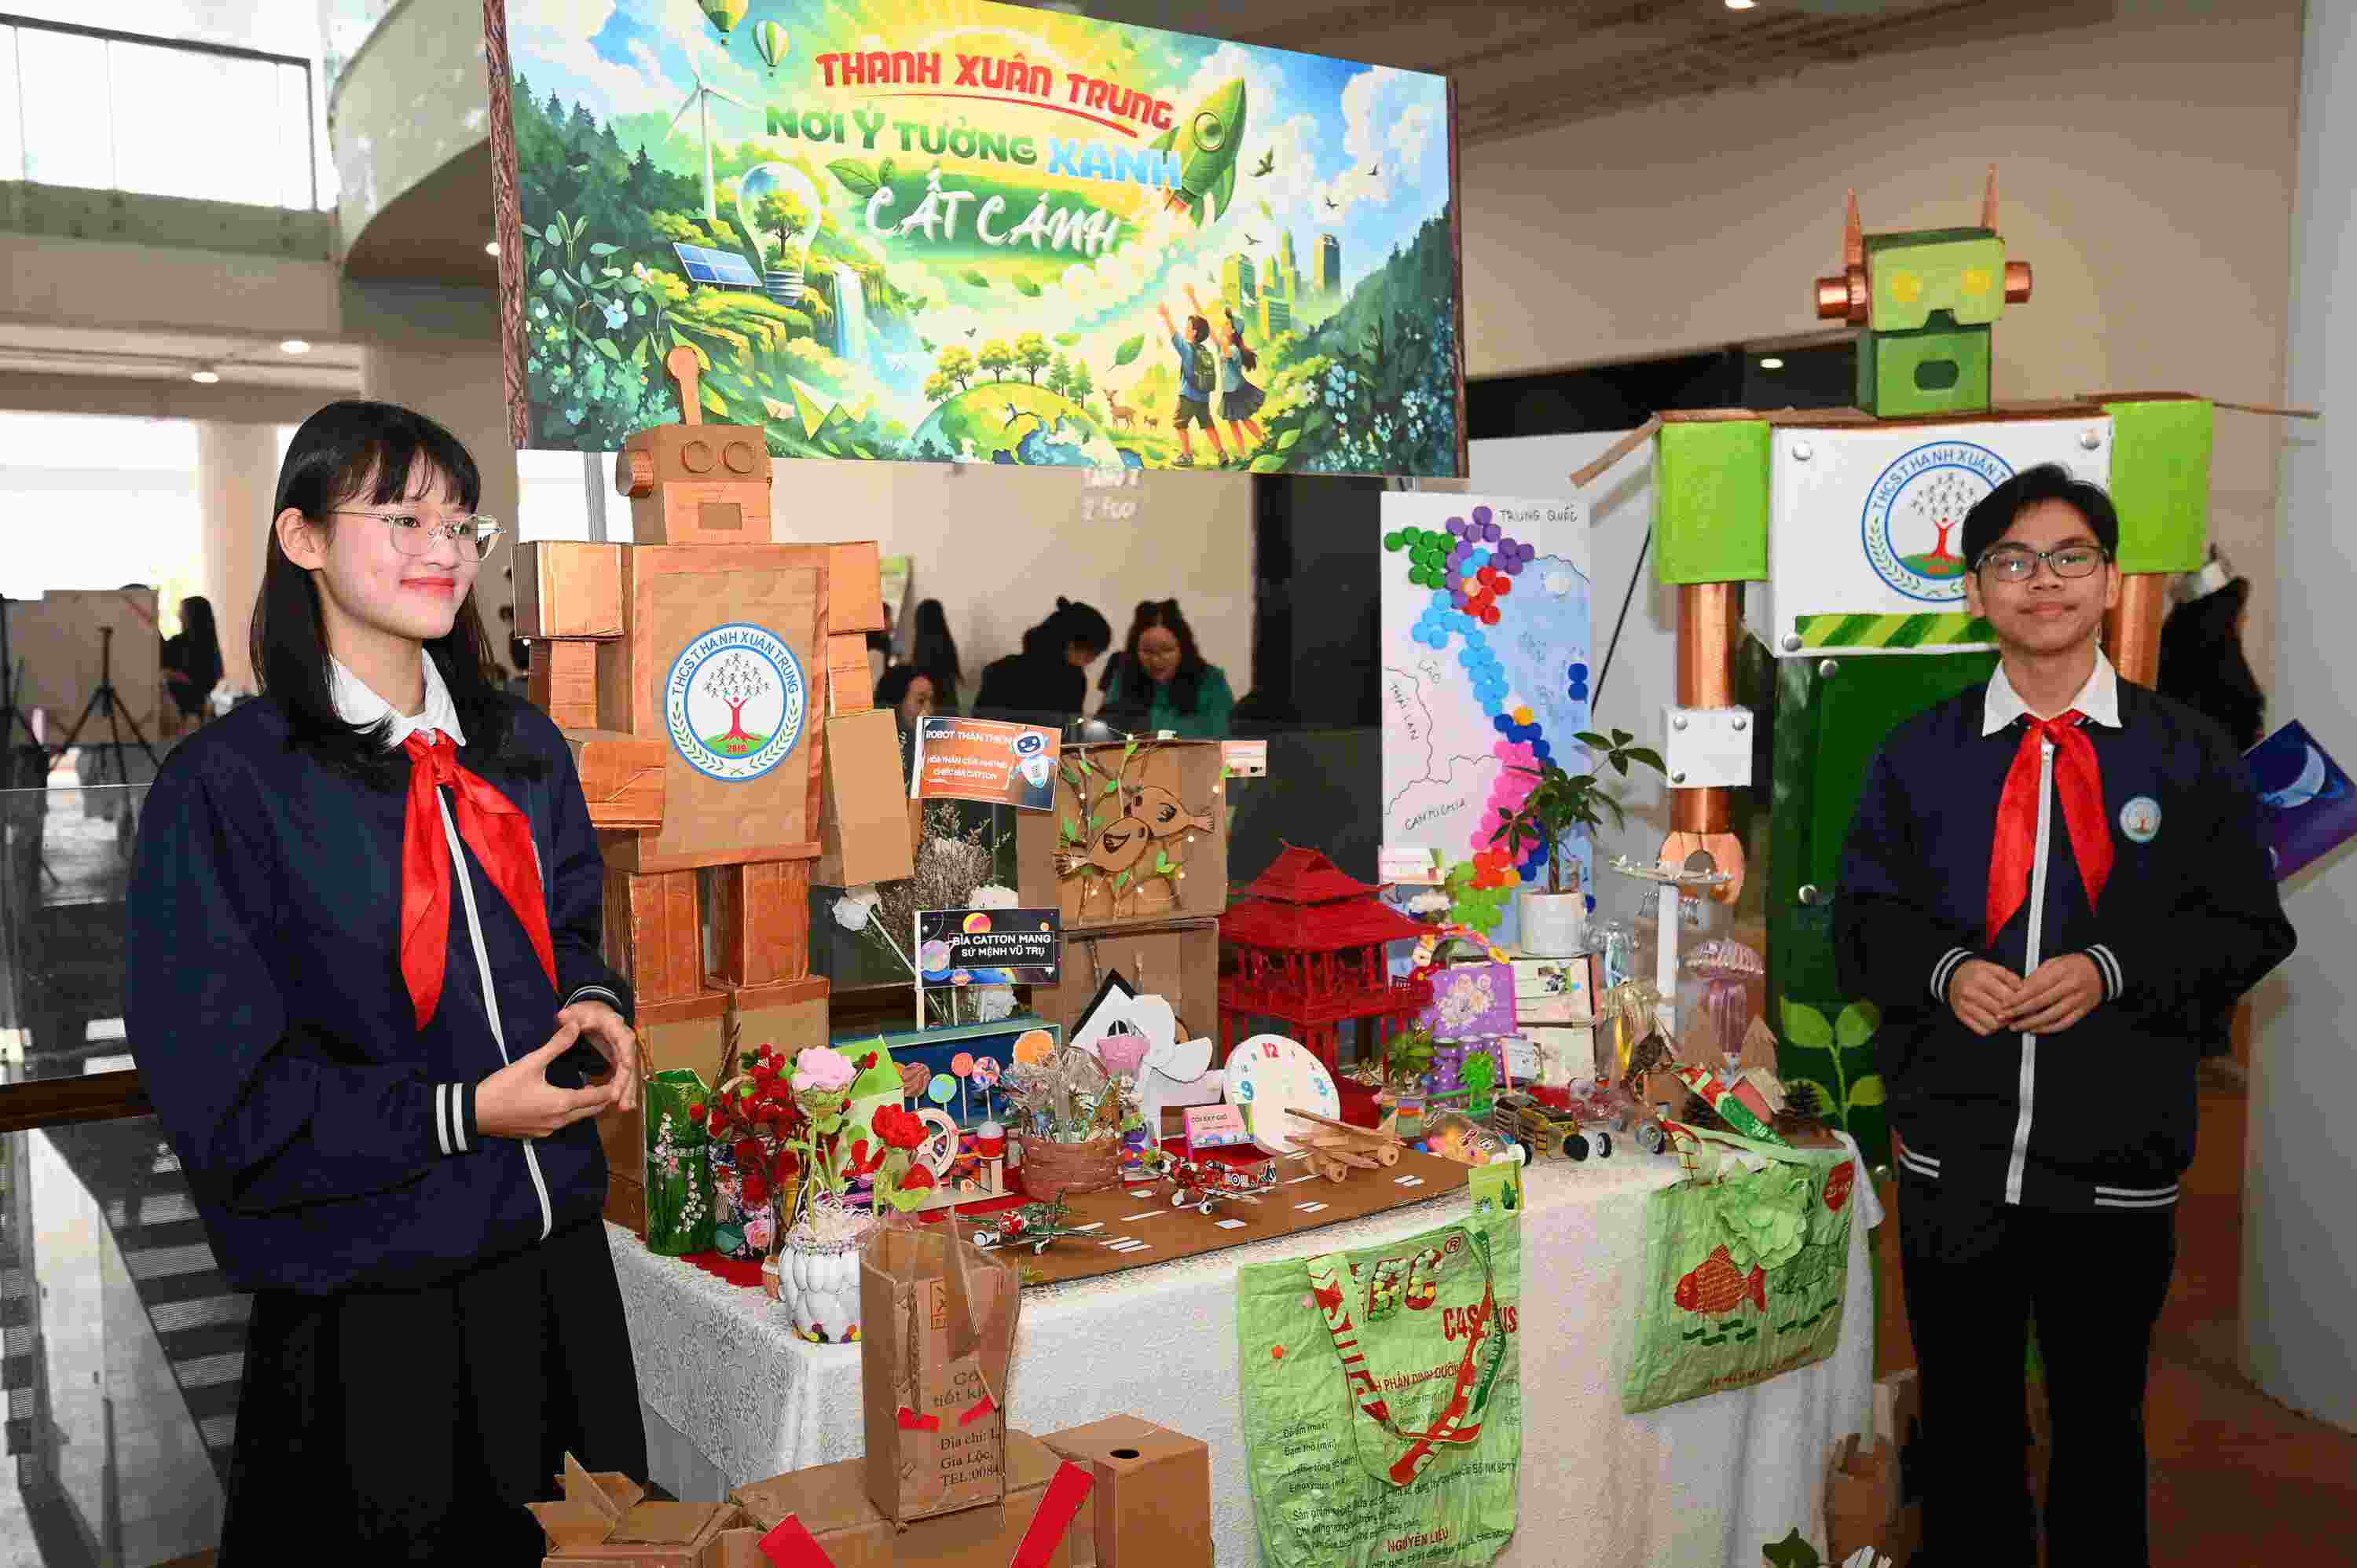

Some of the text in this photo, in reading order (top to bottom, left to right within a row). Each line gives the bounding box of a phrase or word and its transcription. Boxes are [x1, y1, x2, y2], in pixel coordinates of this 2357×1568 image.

[816, 52, 1174, 130] THANH XUÂN TRUNG
[767, 101, 1182, 190] NƠI Ý TƯỞNG XANH
[867, 160, 1120, 258] CẤT CÁNH
[1873, 474, 1902, 511] THCS
[1900, 449, 1954, 478] THANH
[1500, 509, 1540, 522] TRUNG
[673, 658, 695, 696] THCS
[691, 631, 738, 661] THANH
[774, 649, 800, 694] TRUNG
[926, 730, 955, 740] ROBOT
[953, 934, 1051, 946] BÌA CATTON MANG
[978, 946, 1008, 958] MỆNH
[1010, 944, 1023, 955] VŨ
[1025, 946, 1046, 957] TRỤ
[1262, 1042, 1280, 1058] 12
[1241, 1080, 1253, 1101] 9
